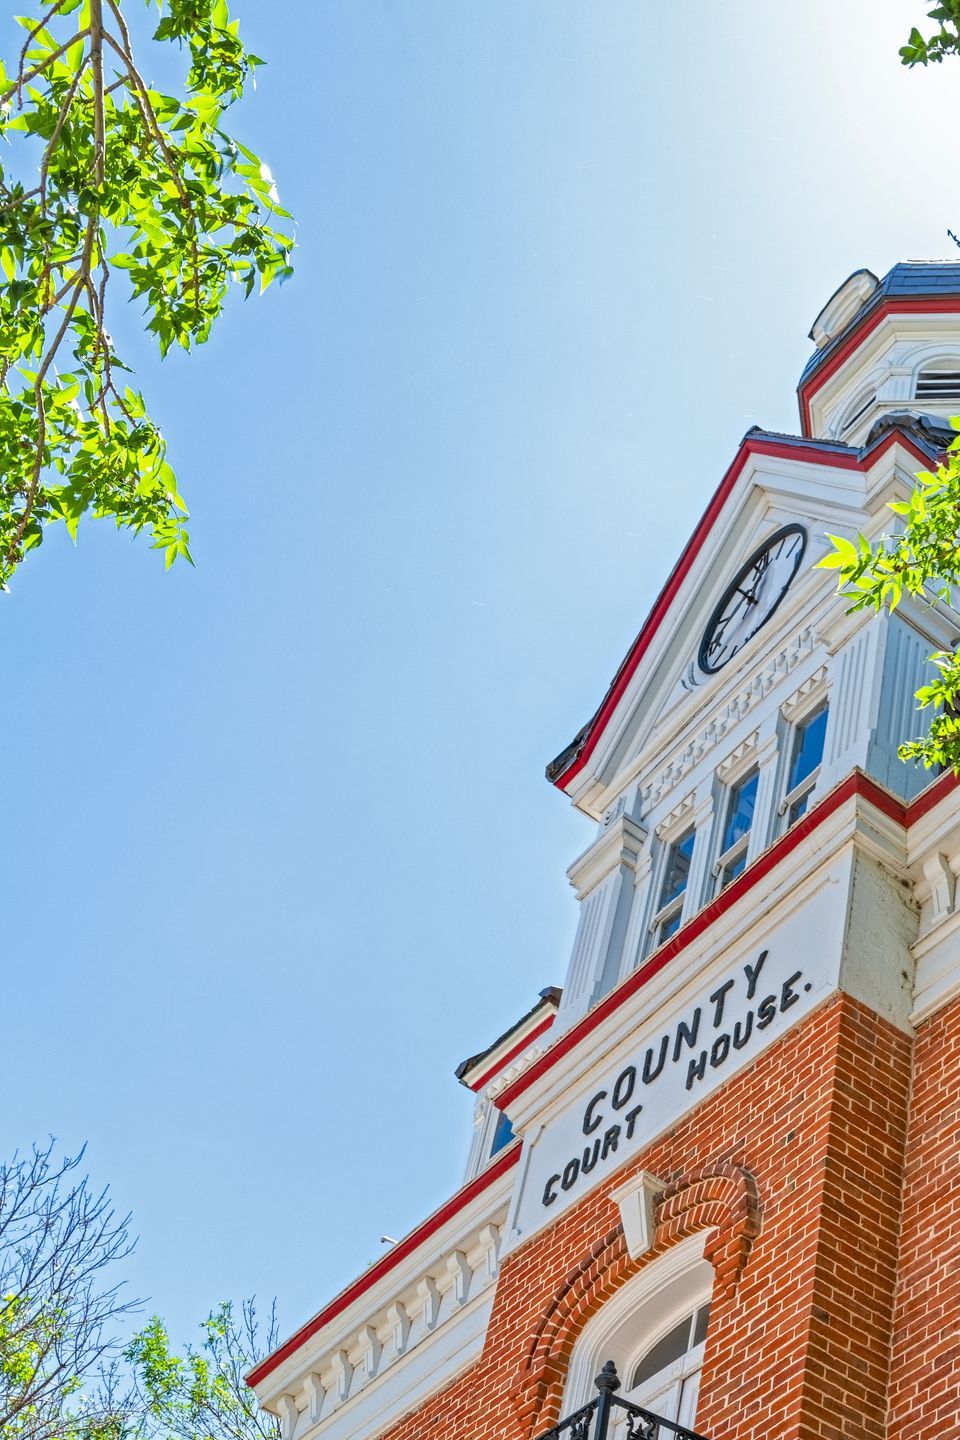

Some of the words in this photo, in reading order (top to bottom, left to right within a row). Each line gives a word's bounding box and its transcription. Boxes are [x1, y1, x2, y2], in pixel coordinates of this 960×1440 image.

[542, 1104, 643, 1207] COURT
[685, 970, 812, 1090] HOUSE.
[583, 950, 769, 1136] COUNTY
